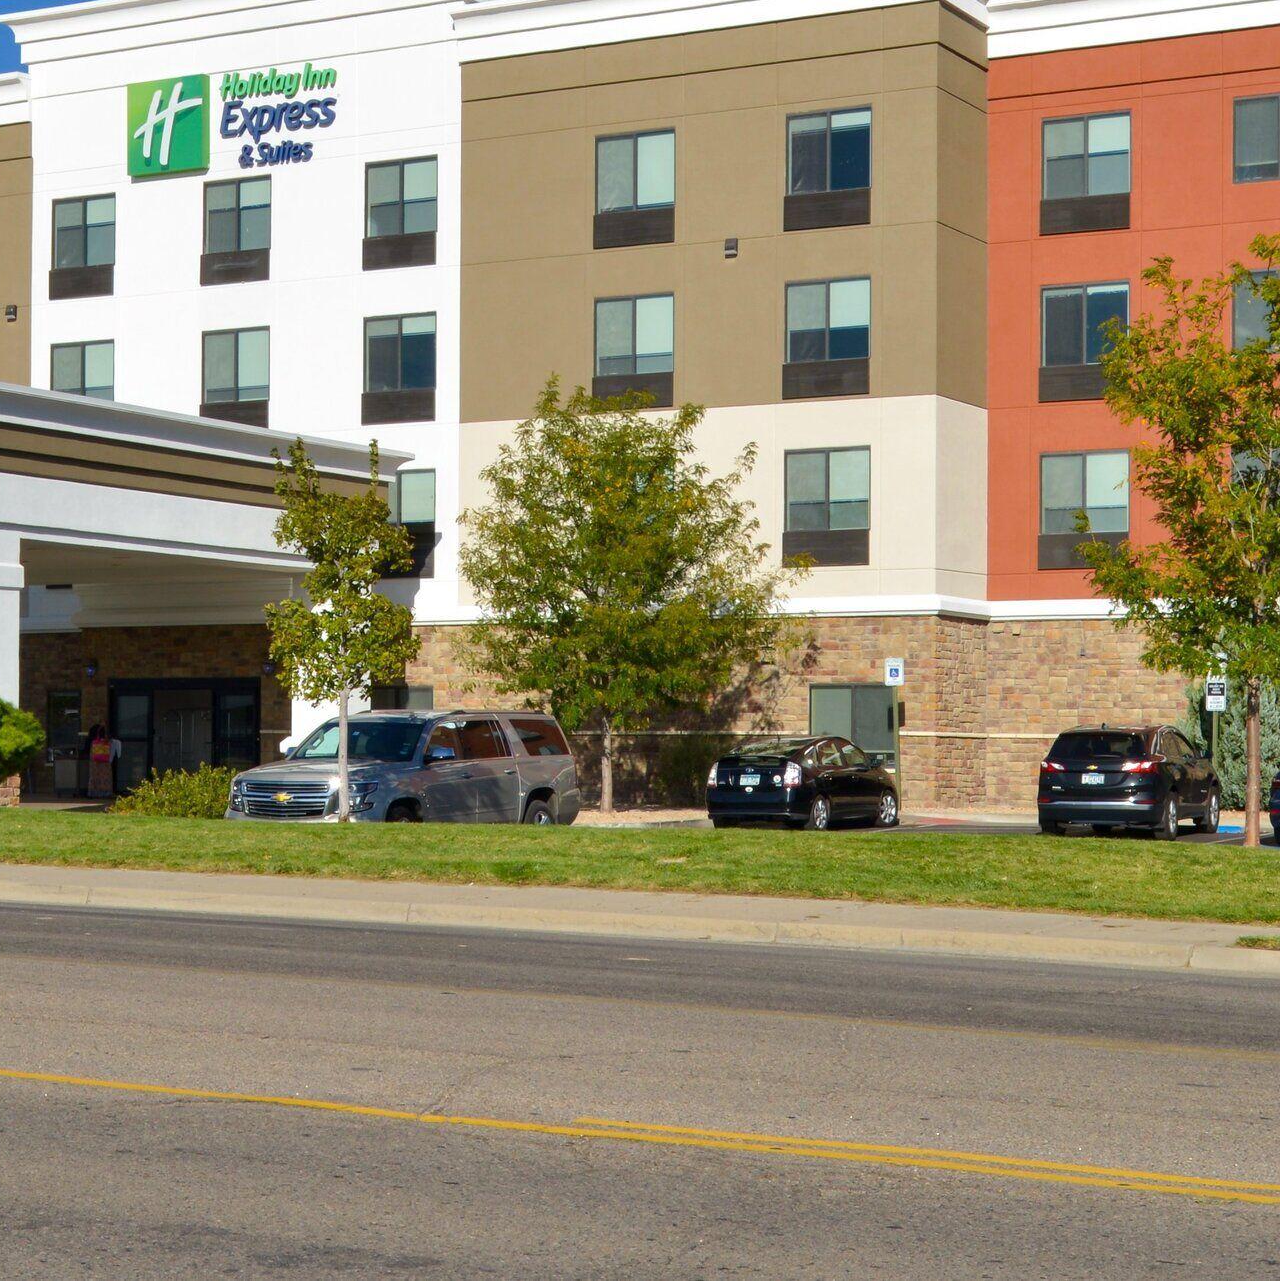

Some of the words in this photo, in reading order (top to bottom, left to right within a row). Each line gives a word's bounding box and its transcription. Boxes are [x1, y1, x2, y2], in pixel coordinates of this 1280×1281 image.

[220, 68, 300, 101] Holiday
[302, 62, 337, 90] Inn
[134, 81, 202, 166] H
[220, 98, 337, 143] Express
[238, 144, 255, 168] &
[256, 141, 313, 167] Suites
